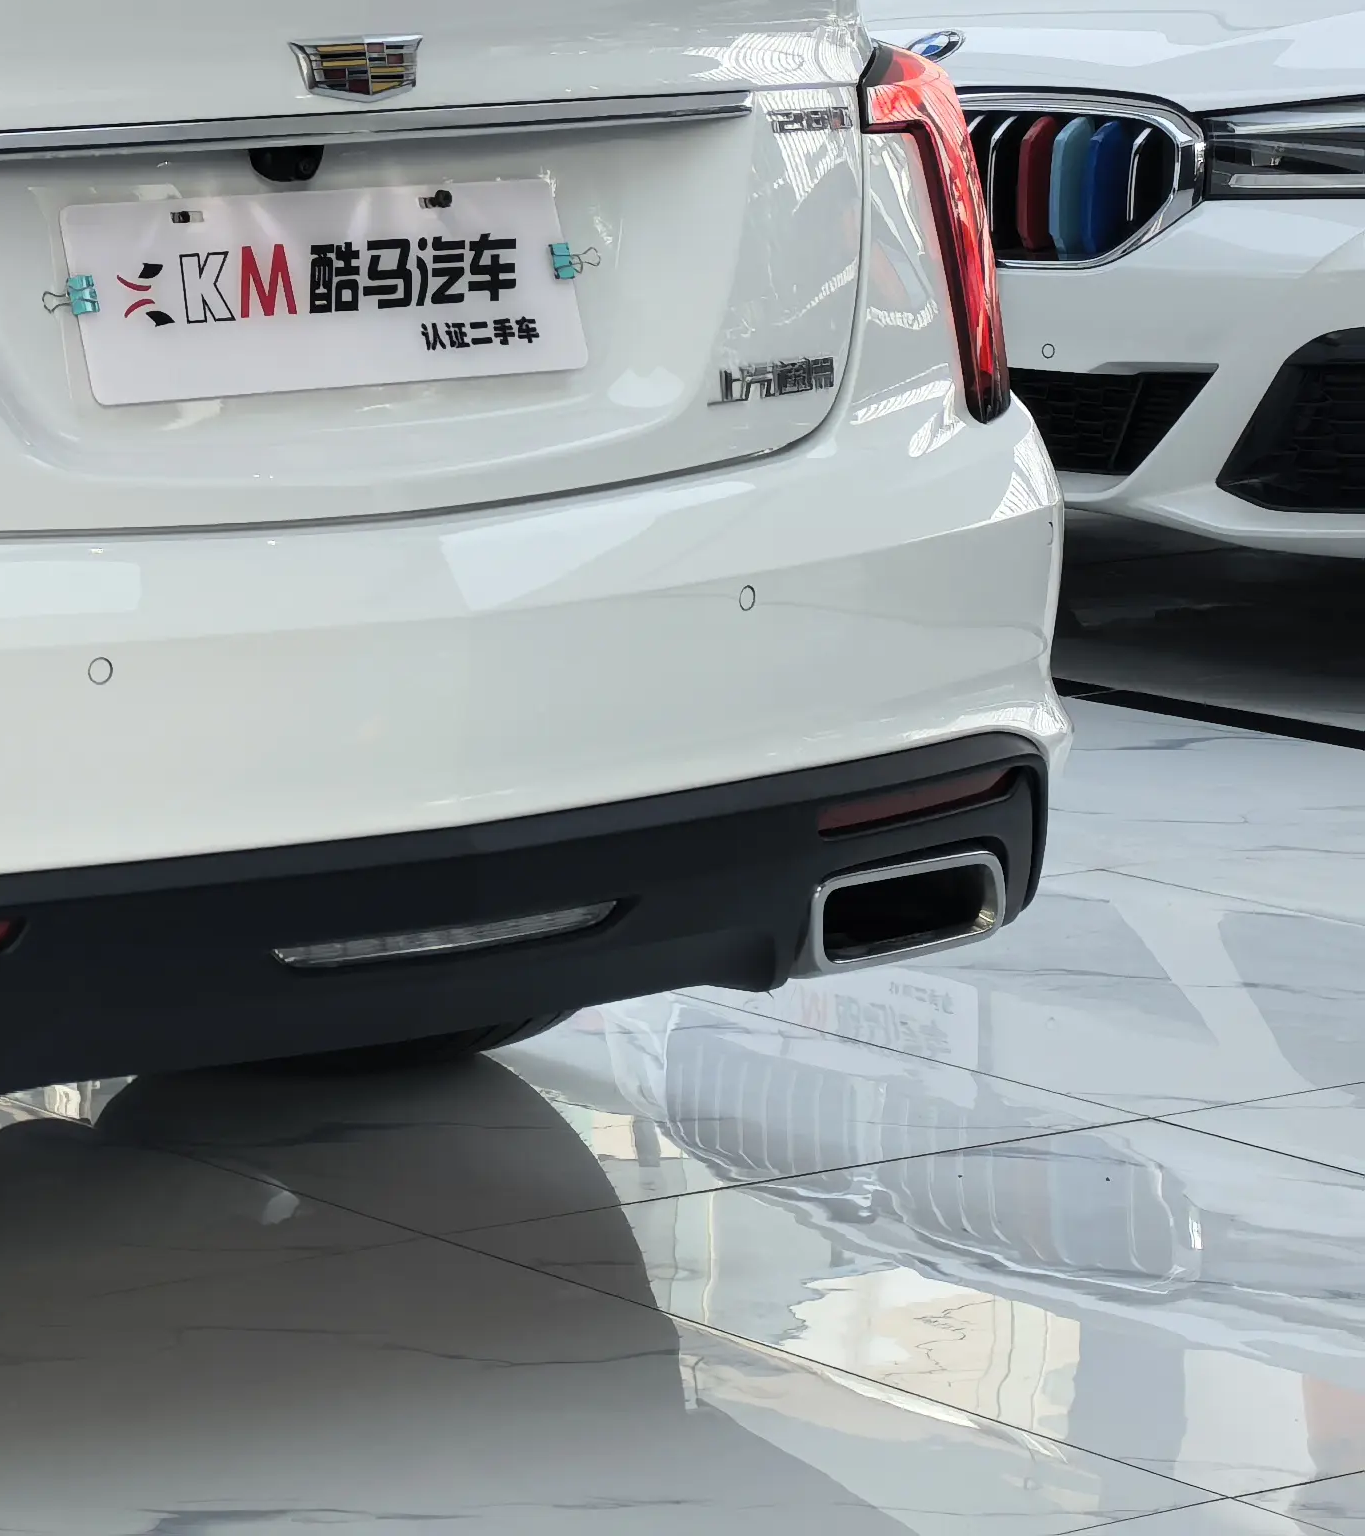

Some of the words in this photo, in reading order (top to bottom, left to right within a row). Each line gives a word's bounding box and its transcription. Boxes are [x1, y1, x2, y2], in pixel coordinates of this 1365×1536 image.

[309, 232, 518, 314] 酷马汽车
[420, 316, 540, 352] 认证二手车
